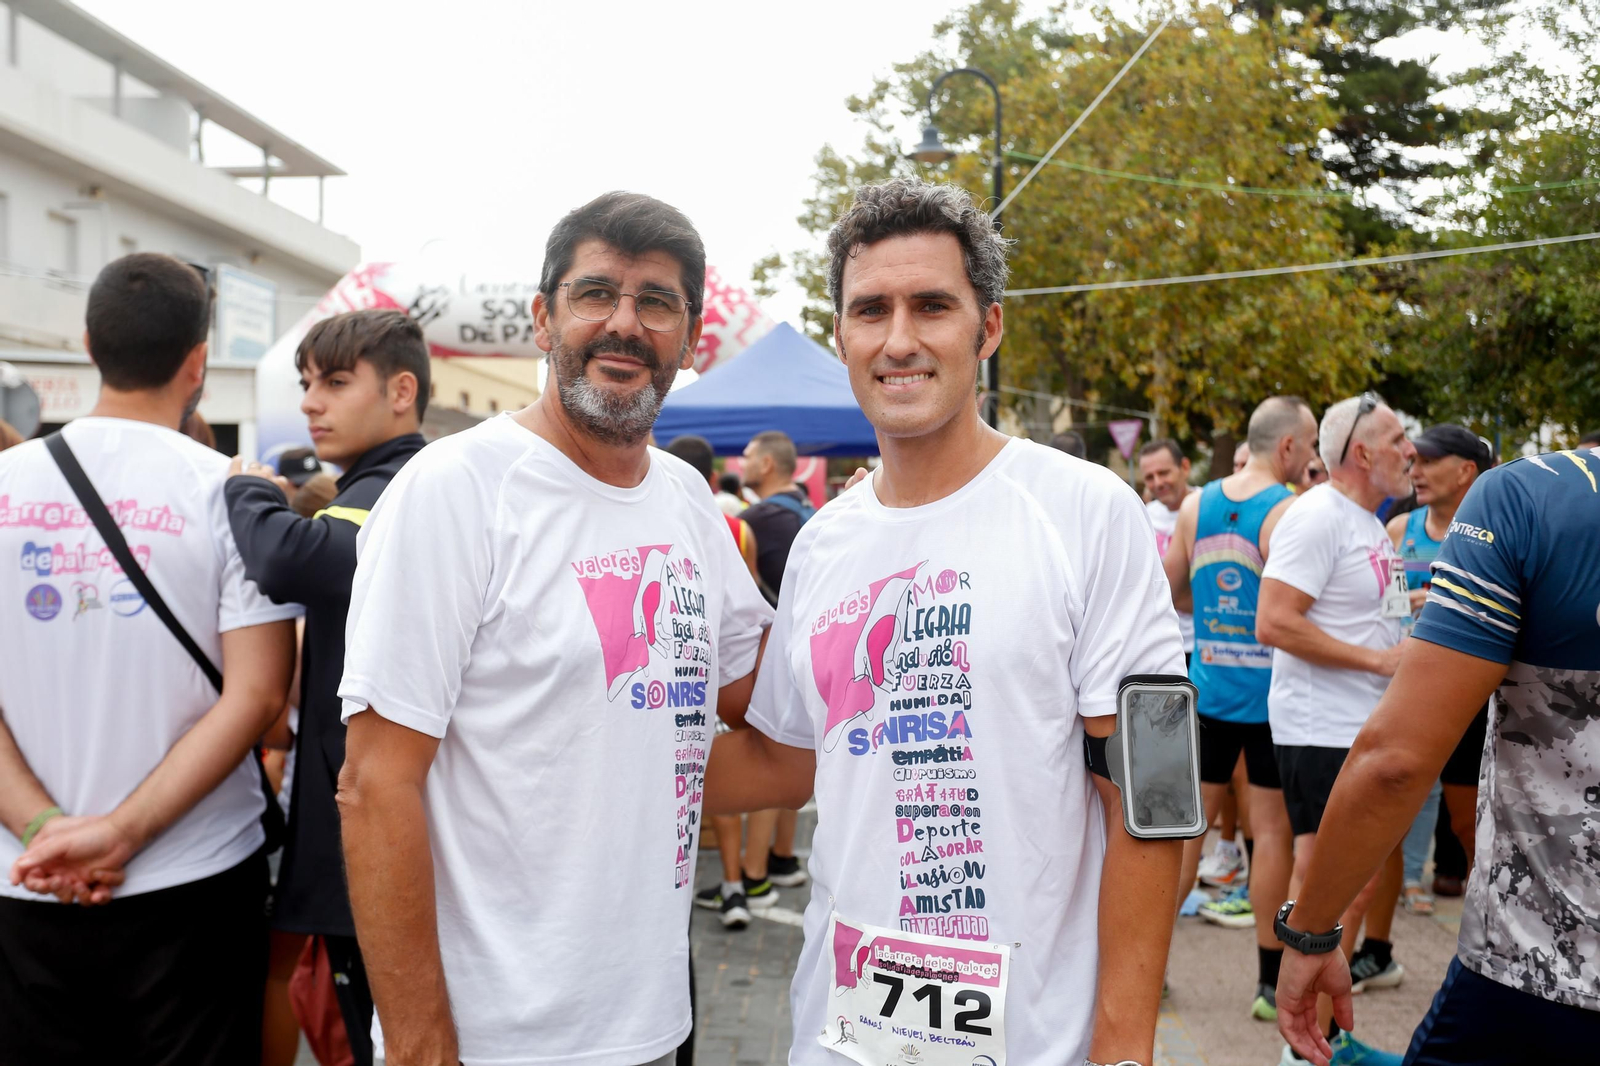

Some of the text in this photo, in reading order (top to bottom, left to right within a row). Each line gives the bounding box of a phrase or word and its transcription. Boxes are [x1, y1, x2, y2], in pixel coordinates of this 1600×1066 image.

[571, 552, 640, 576] valores
[666, 557, 703, 586] AMOR
[811, 592, 869, 636] valores
[892, 673, 972, 692] FUERZA
[889, 691, 972, 711] HUMILDAD
[893, 767, 977, 782] altruismo
[896, 818, 981, 848] Deporte
[900, 837, 984, 867] COLABORAR
[956, 961, 999, 980] valores
[873, 972, 993, 1037] 712
